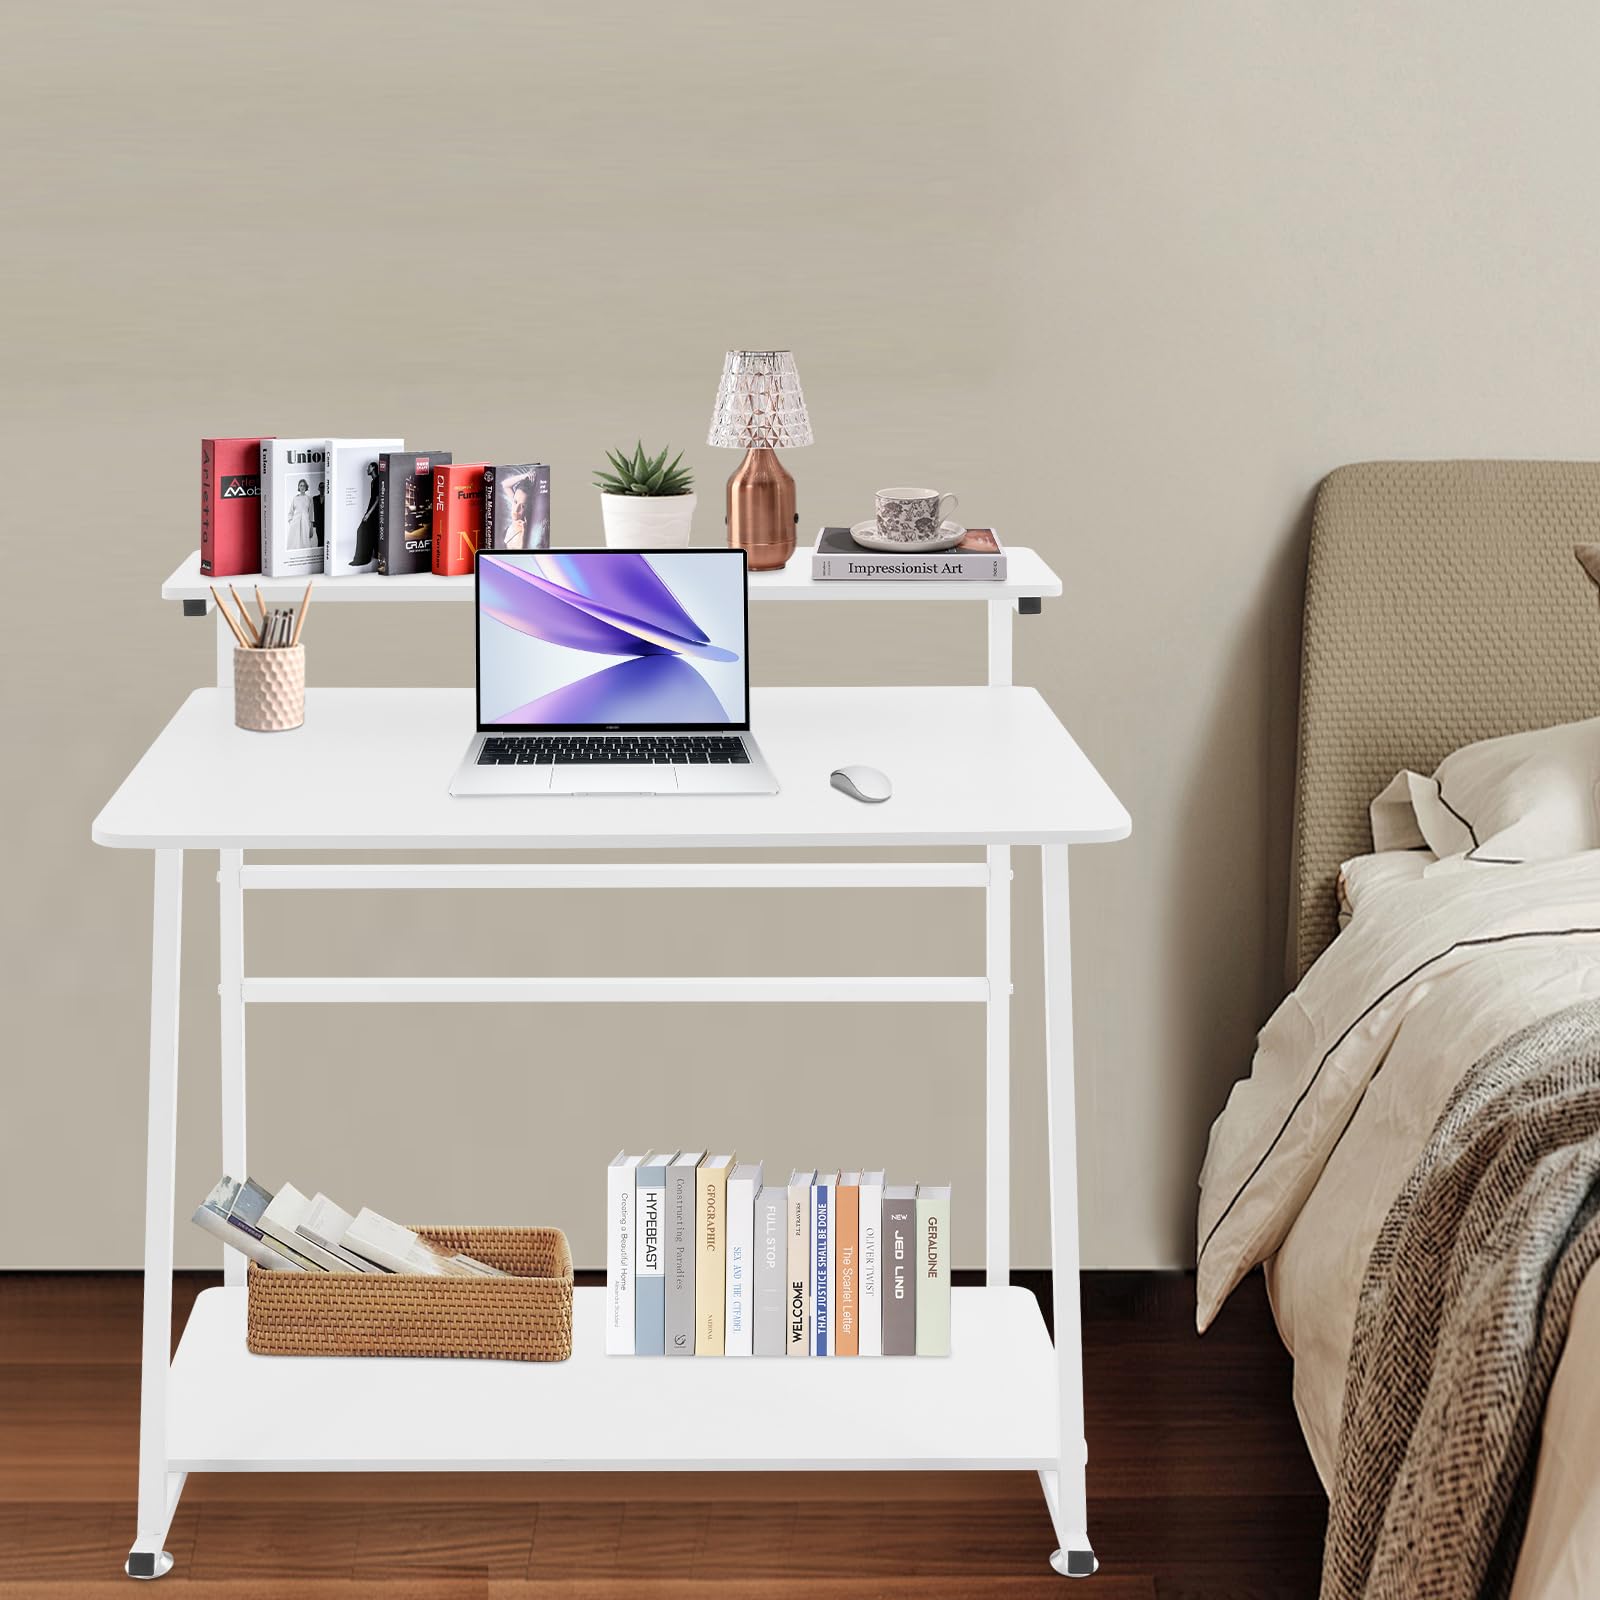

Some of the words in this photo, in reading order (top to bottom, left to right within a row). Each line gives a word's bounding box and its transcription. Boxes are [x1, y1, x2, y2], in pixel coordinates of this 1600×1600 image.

[848, 562, 938, 576] Impressionist
[941, 562, 963, 574] Art
[620, 1192, 629, 1225] Creating
[675, 1178, 685, 1243] Constructing
[766, 1205, 776, 1235] FULL
[817, 1203, 827, 1227] DONE
[646, 1192, 658, 1270] HYPEBEAST
[817, 1227, 827, 1239] BE
[865, 1227, 875, 1263] OLIVER
[894, 1230, 904, 1260] JED
[620, 1233, 628, 1267] Beautiful
[733, 1247, 742, 1262] SEX
[766, 1237, 776, 1269] STOP
[817, 1240, 827, 1267] SHALL
[842, 1246, 854, 1265] The
[927, 1216, 938, 1279] GERALDINE
[620, 1268, 628, 1291] Home
[676, 1247, 685, 1290] Paradies
[733, 1264, 742, 1280] AND
[842, 1267, 854, 1302] Scarlet
[865, 1264, 875, 1297] TWIST
[894, 1265, 904, 1300] LIND
[733, 1283, 742, 1298] THE
[817, 1269, 827, 1307] JUSTICE
[792, 1281, 803, 1343] WELCOME
[817, 1309, 827, 1334] THAT
[842, 1303, 854, 1335] Letter
